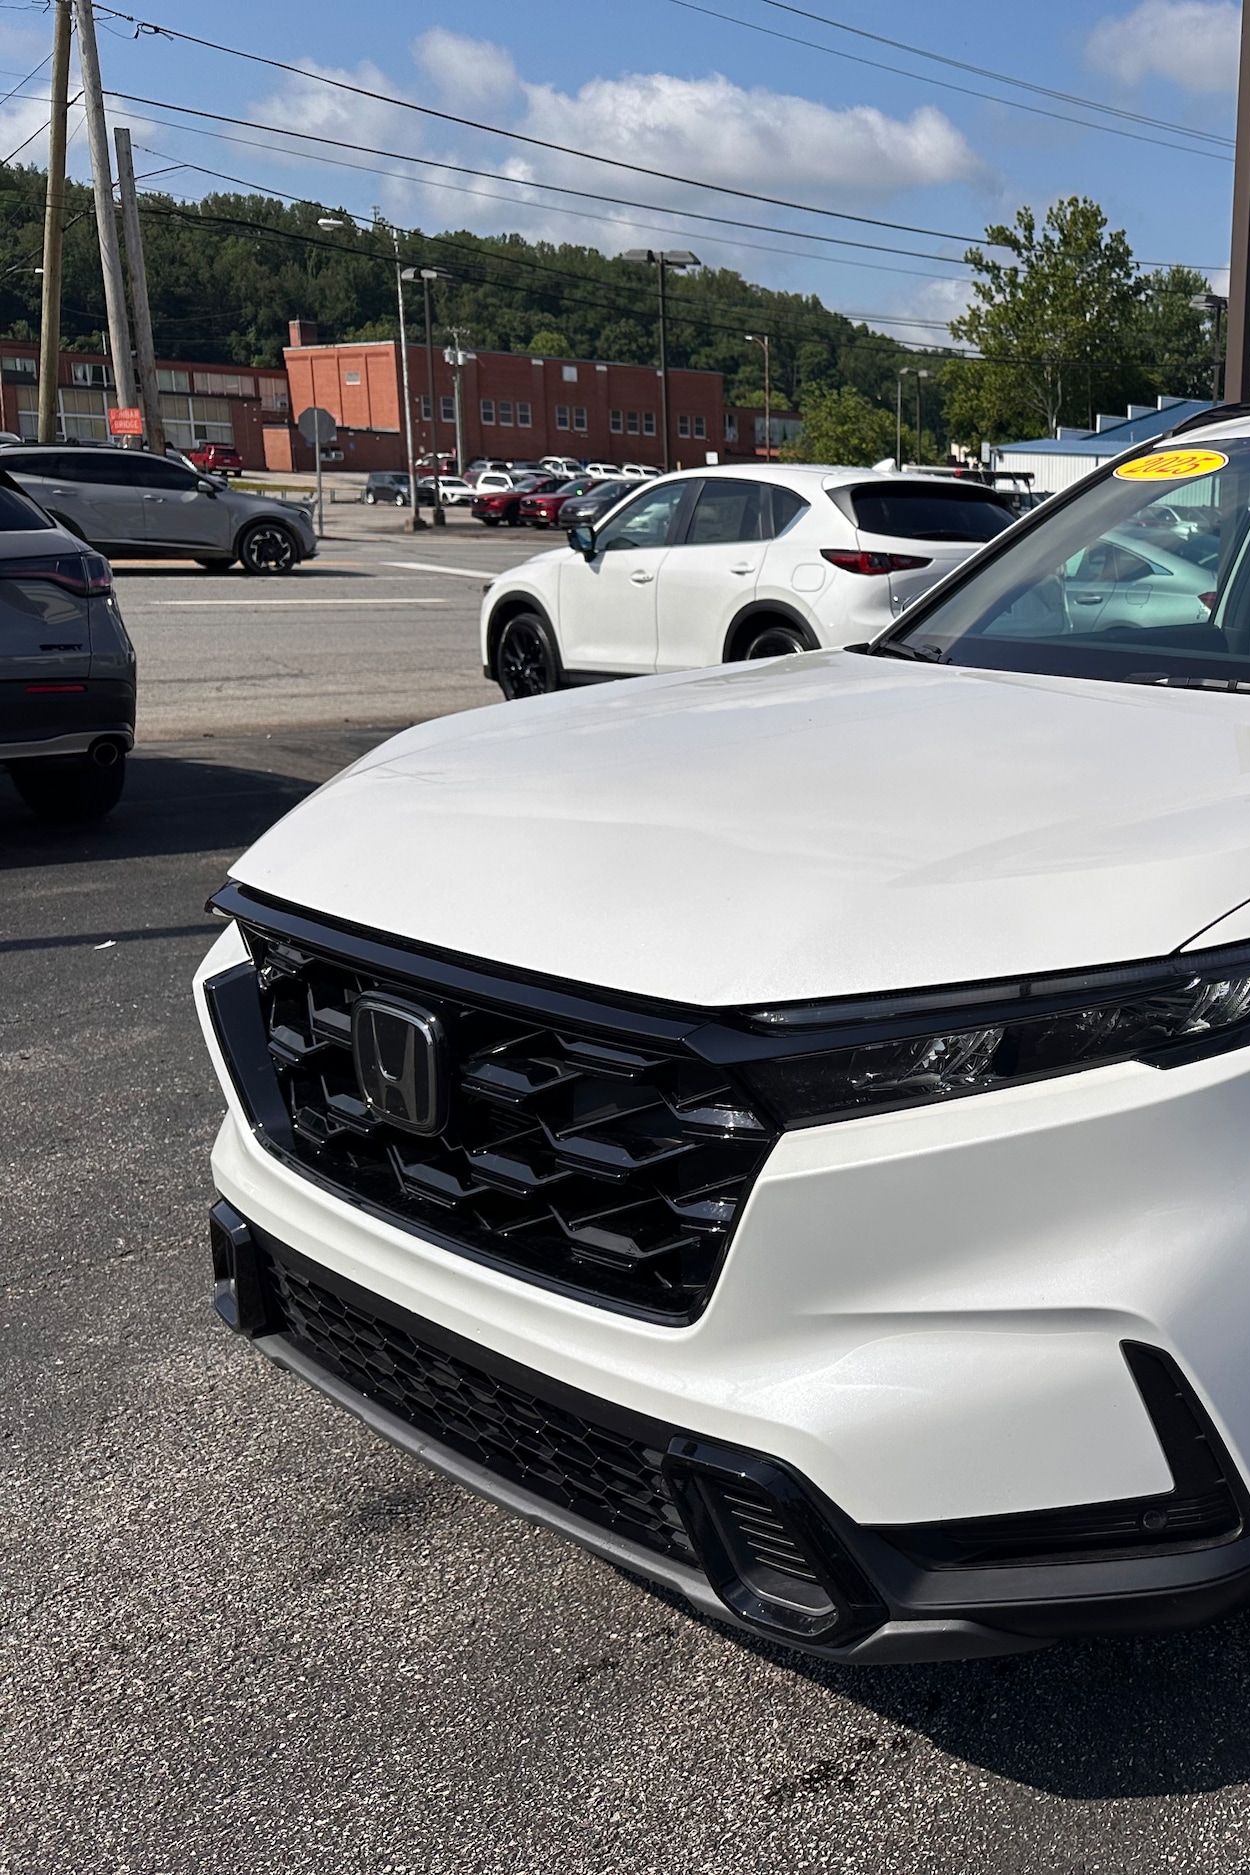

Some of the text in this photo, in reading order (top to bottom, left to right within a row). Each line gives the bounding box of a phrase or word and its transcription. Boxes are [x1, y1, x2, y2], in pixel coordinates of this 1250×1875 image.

[113, 420, 139, 429] BRIDGE
[1123, 456, 1217, 475] 2025
[39, 644, 83, 652] SPORT
